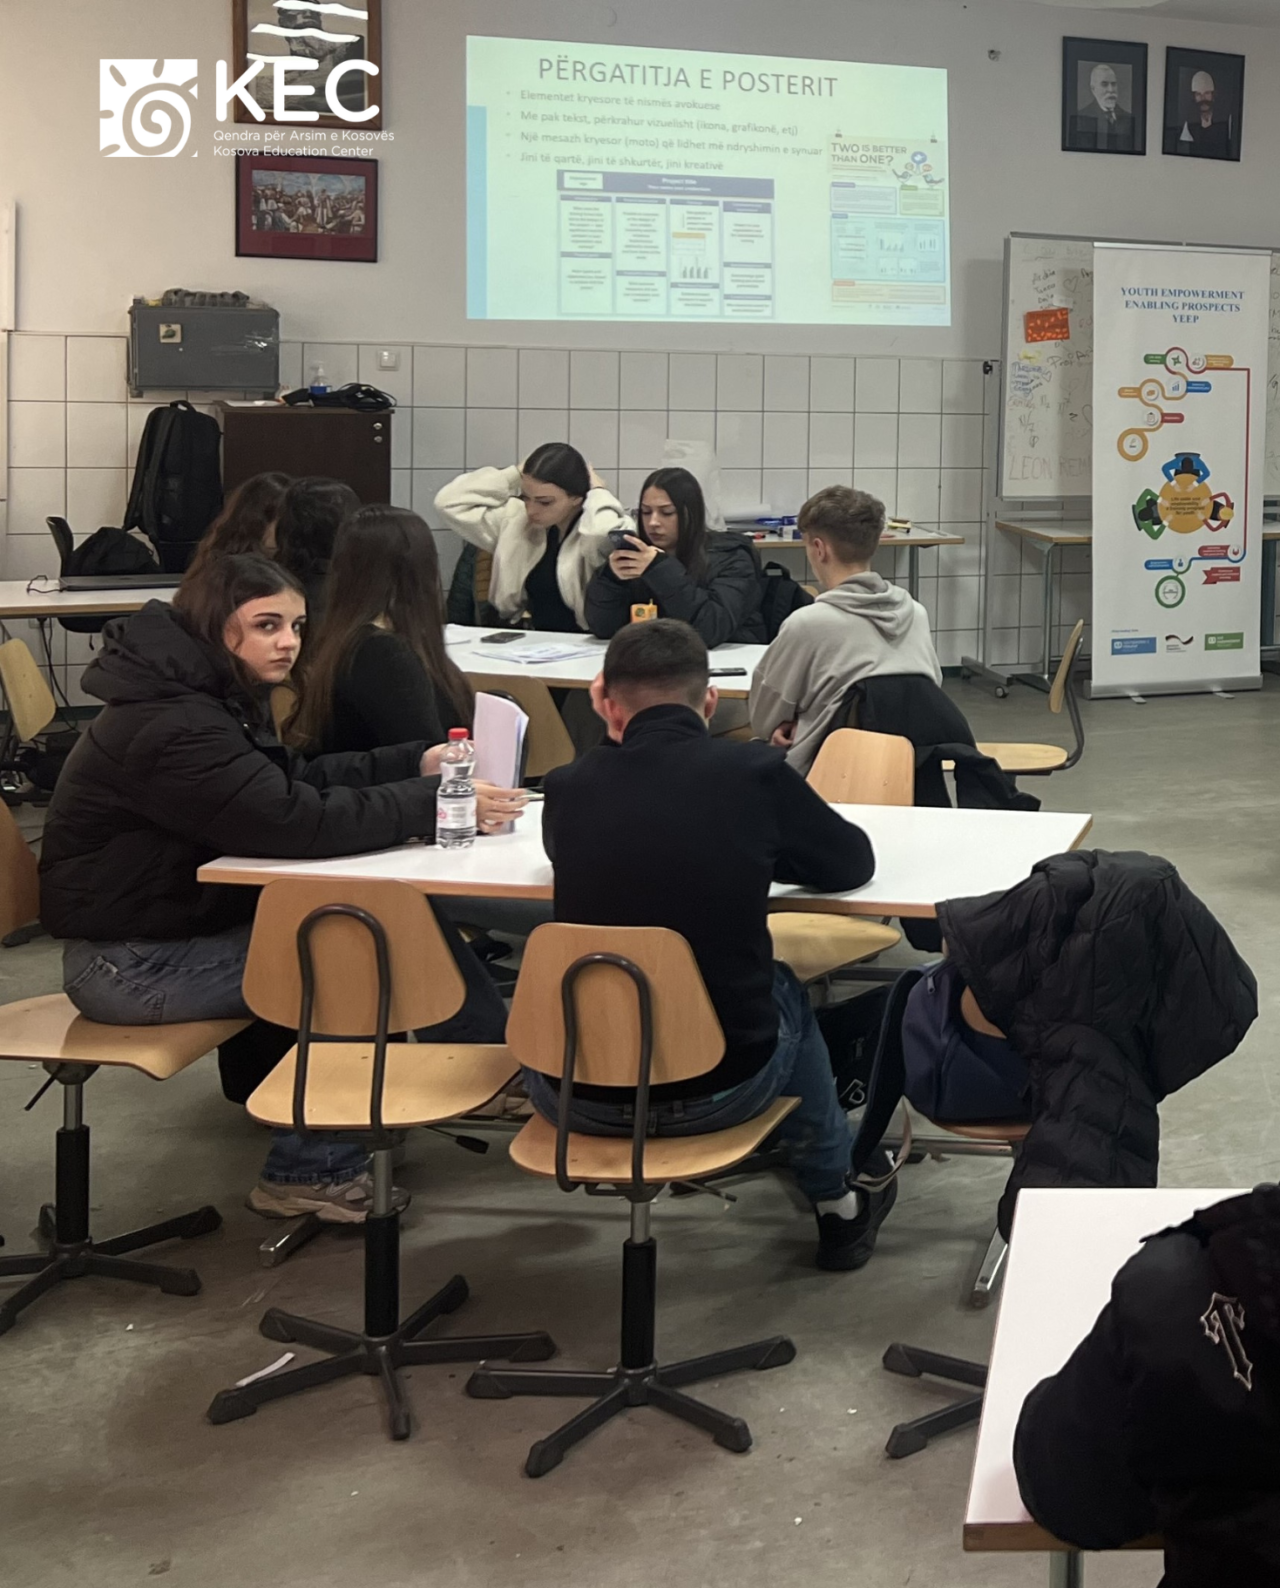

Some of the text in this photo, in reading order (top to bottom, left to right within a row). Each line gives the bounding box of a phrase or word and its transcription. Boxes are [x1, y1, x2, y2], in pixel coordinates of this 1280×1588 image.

[539, 55, 838, 97] PËRGATITJA E POSTERIT
[520, 89, 721, 111] Elementet kryesore të nismës avokuese
[520, 110, 539, 121] Me
[541, 111, 560, 123] pak
[562, 113, 592, 125] tekst,
[593, 115, 645, 127] përkrahur
[647, 118, 694, 129] vizuelisht
[520, 131, 539, 143] Një
[541, 133, 582, 144] mesazh
[584, 134, 622, 147] kryesor
[625, 137, 660, 149] (moto)
[677, 138, 706, 150] lidhet
[726, 141, 781, 154] ndryshimin
[791, 146, 823, 157] synuar
[831, 142, 907, 154] TWO IS BETTER
[684, 158, 724, 170] kreativë
[831, 154, 894, 166] THAN ONE?
[1120, 287, 1245, 300] YOUTH EMPOWERMENT
[1125, 300, 1241, 312] ENABLING PROSPECTS
[1172, 314, 1200, 324] YEEP
